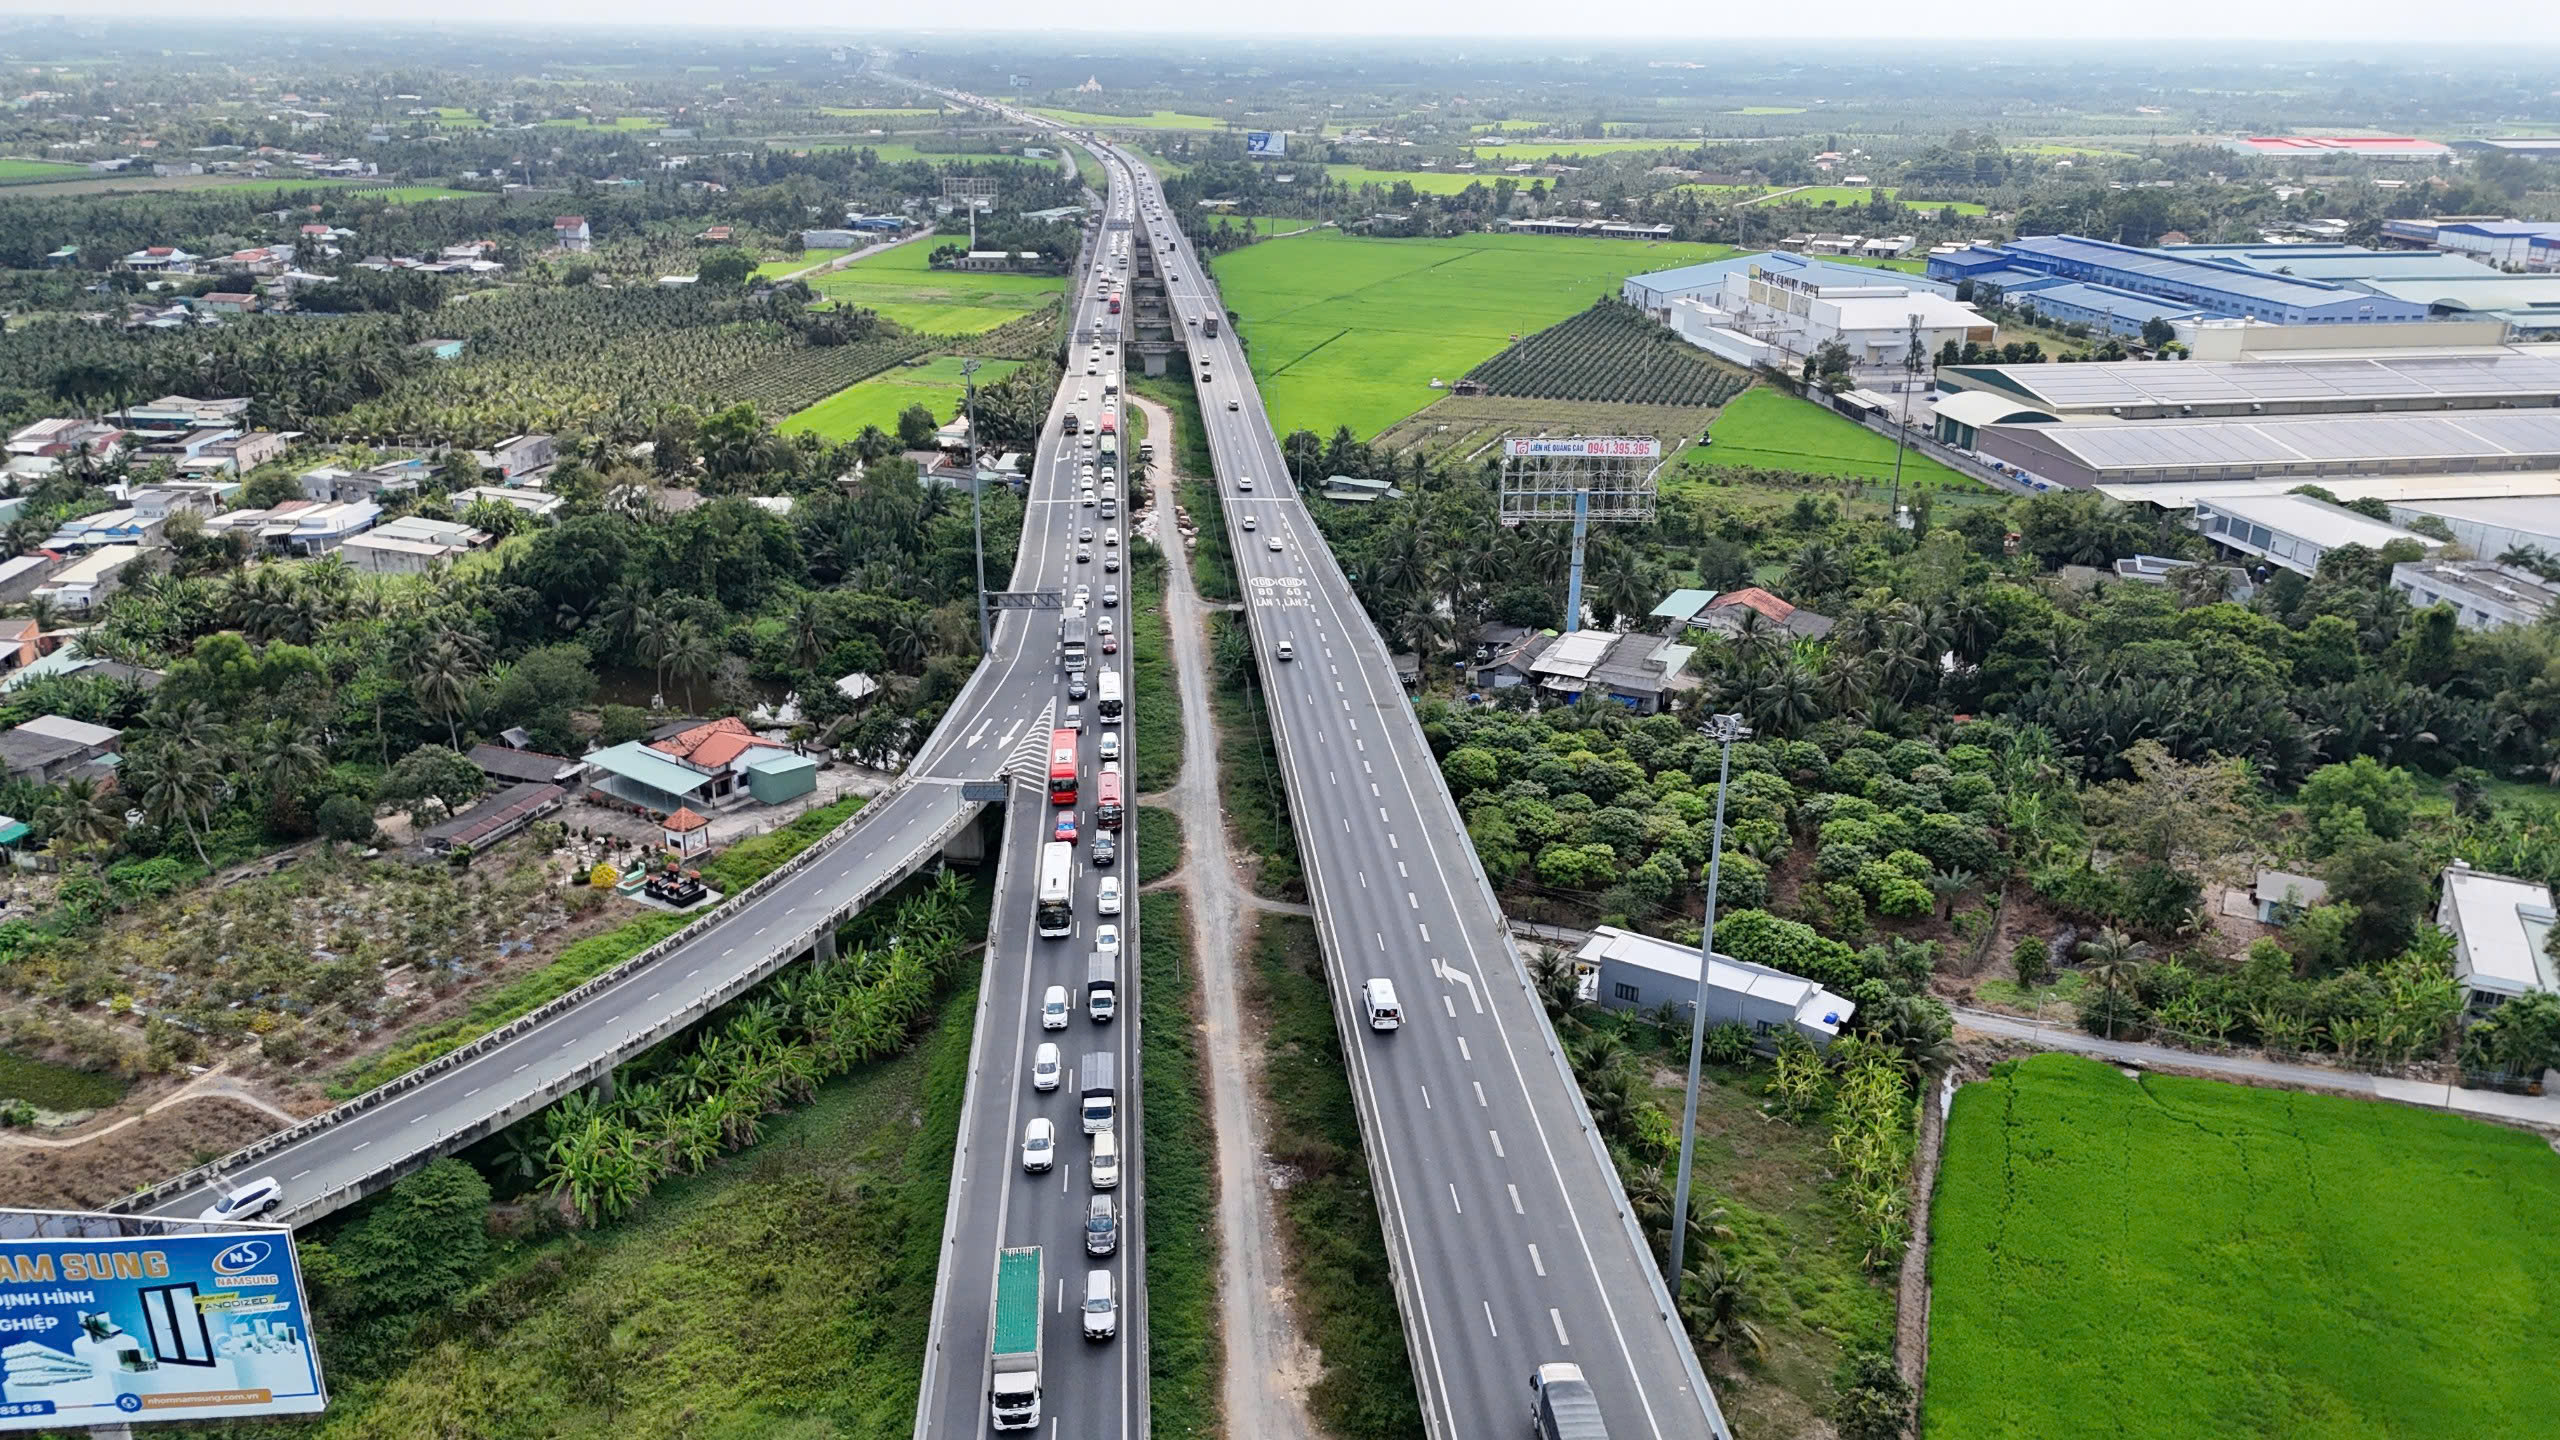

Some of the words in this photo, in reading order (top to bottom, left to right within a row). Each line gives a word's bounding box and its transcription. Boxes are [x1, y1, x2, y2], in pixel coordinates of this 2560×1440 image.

[1587, 442, 1650, 455] 0941.395.395
[1255, 578, 1271, 586] 100
[1283, 578, 1299, 586] 100
[1303, 598, 1309, 606] 2
[229, 1243, 258, 1264] NS
[60, 1250, 169, 1281] SUNG
[216, 1274, 278, 1287] NAMSUNG
[42, 1287, 95, 1304] HÌNH
[204, 1296, 269, 1310] ANODIZED
[148, 1392, 259, 1405] nhomnamsung.com.vn
